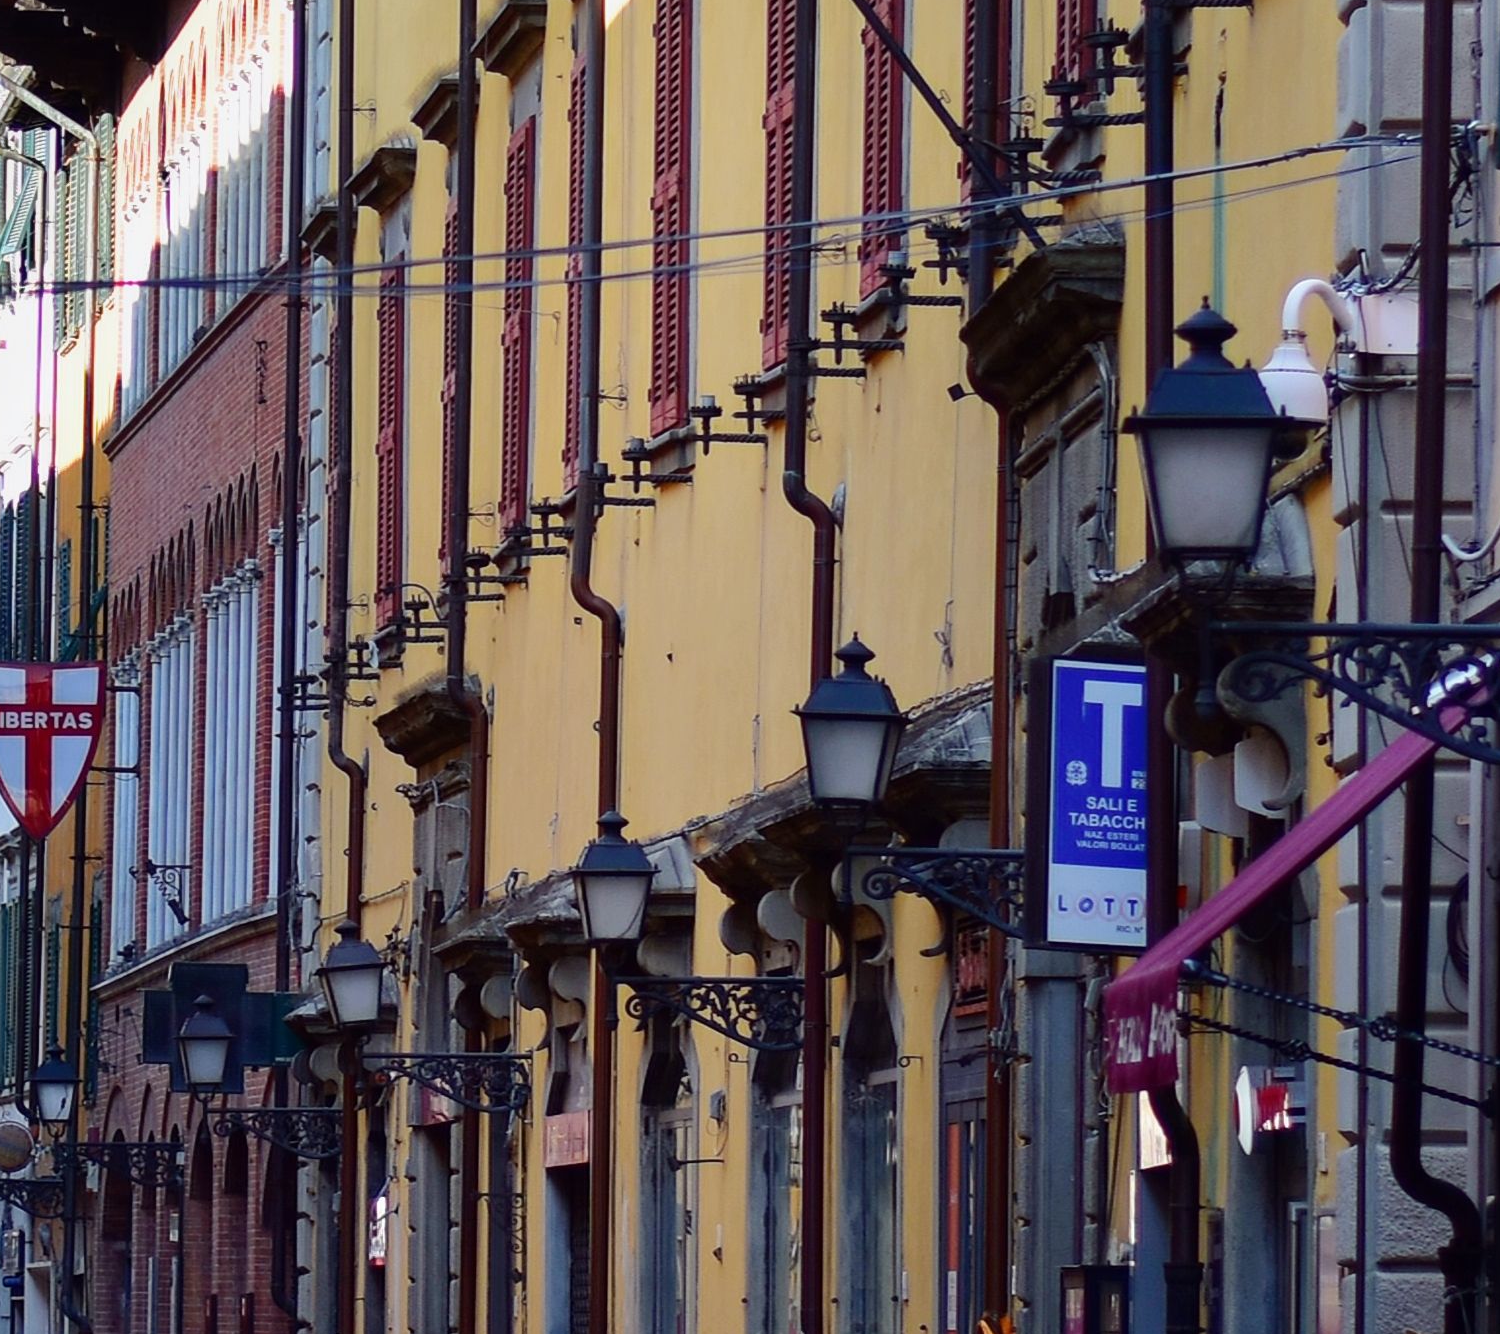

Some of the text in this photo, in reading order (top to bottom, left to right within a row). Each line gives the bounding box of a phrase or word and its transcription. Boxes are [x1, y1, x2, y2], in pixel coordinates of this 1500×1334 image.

[1083, 680, 1143, 788] T
[1086, 796, 1138, 813] SALI E
[1069, 812, 1146, 830] TABACCH
[1106, 831, 1139, 842] ESTERI
[1076, 840, 1146, 852] VALORI BOLLAT
[1058, 894, 1139, 916] LOTT
